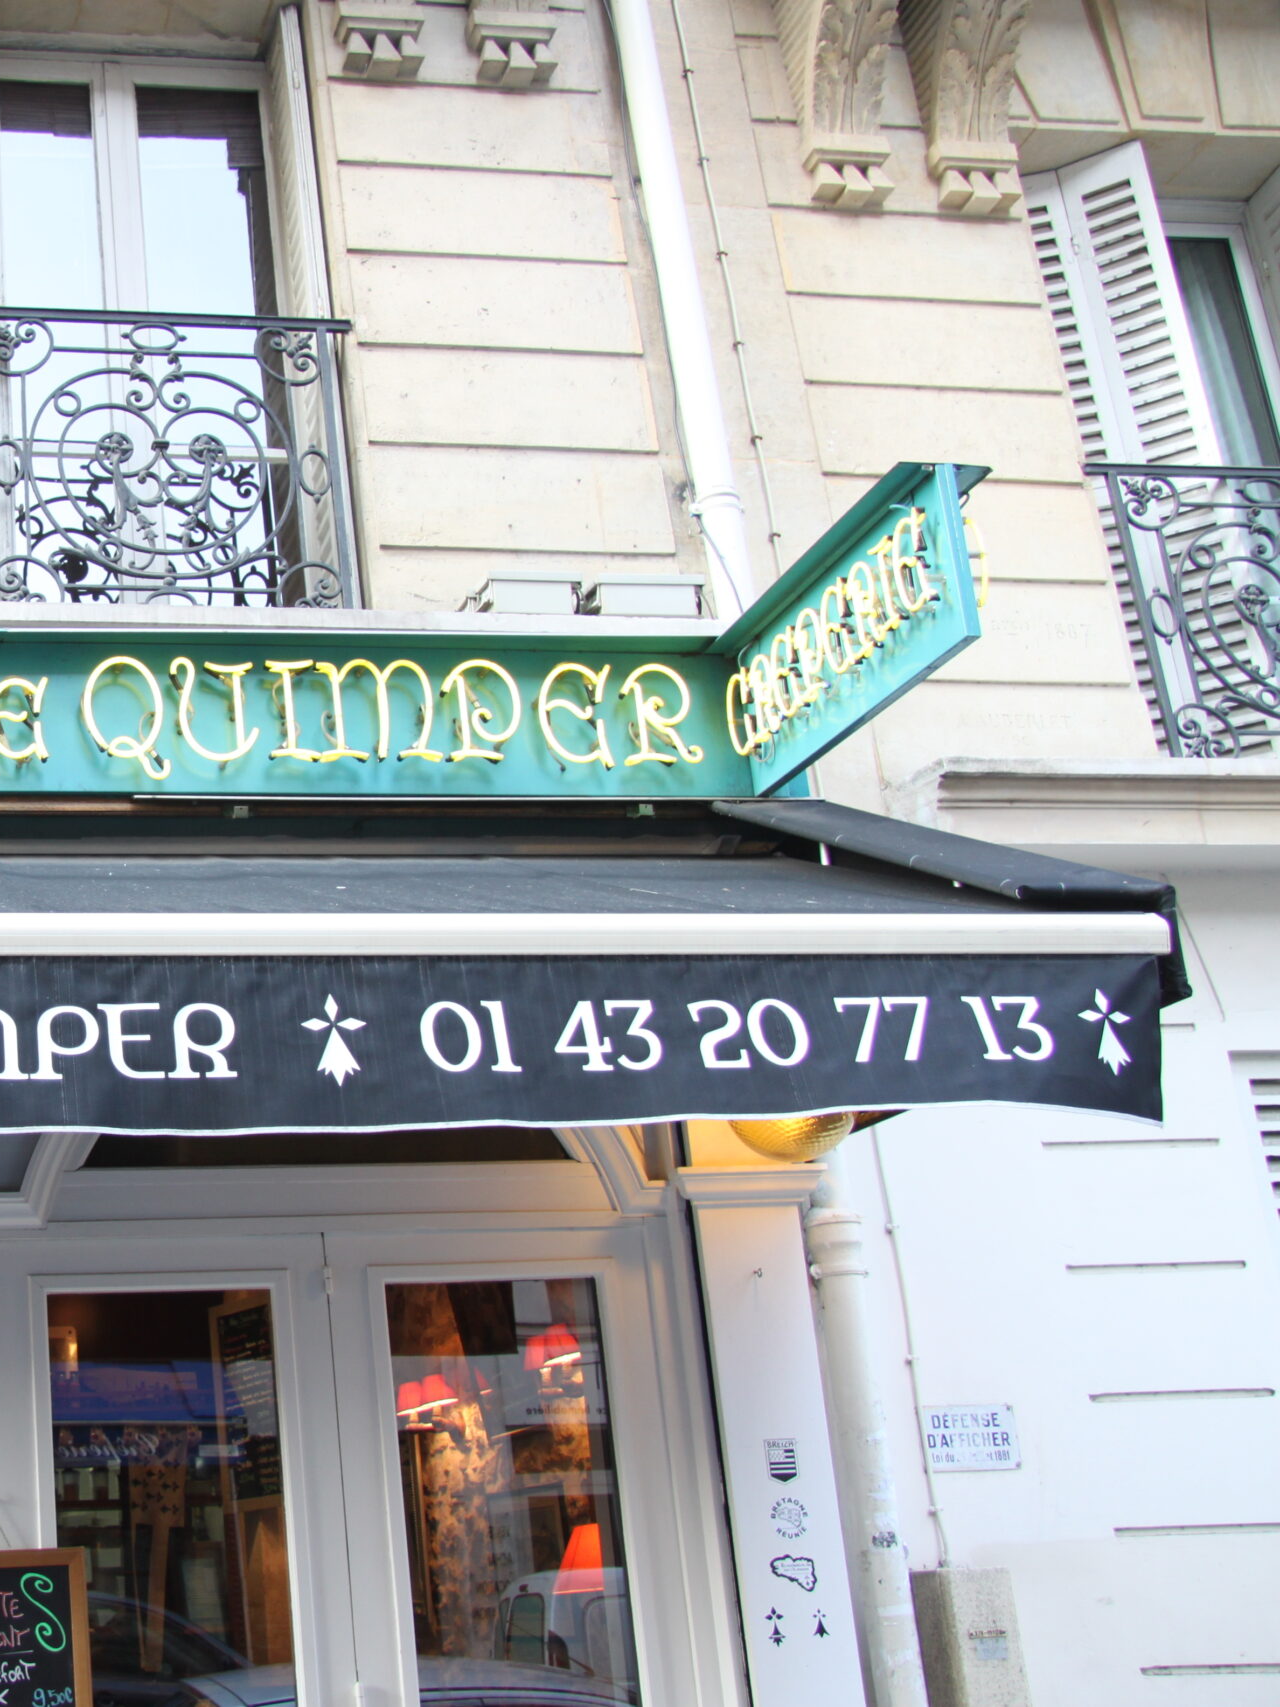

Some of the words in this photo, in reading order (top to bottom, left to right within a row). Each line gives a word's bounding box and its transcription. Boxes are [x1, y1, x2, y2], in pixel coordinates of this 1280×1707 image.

[80, 654, 705, 780] QUIMPER
[420, 1000, 523, 1073] 01
[554, 999, 663, 1072] 43
[686, 998, 810, 1069] 20
[833, 996, 929, 1063] 77
[960, 995, 1054, 1061] 13
